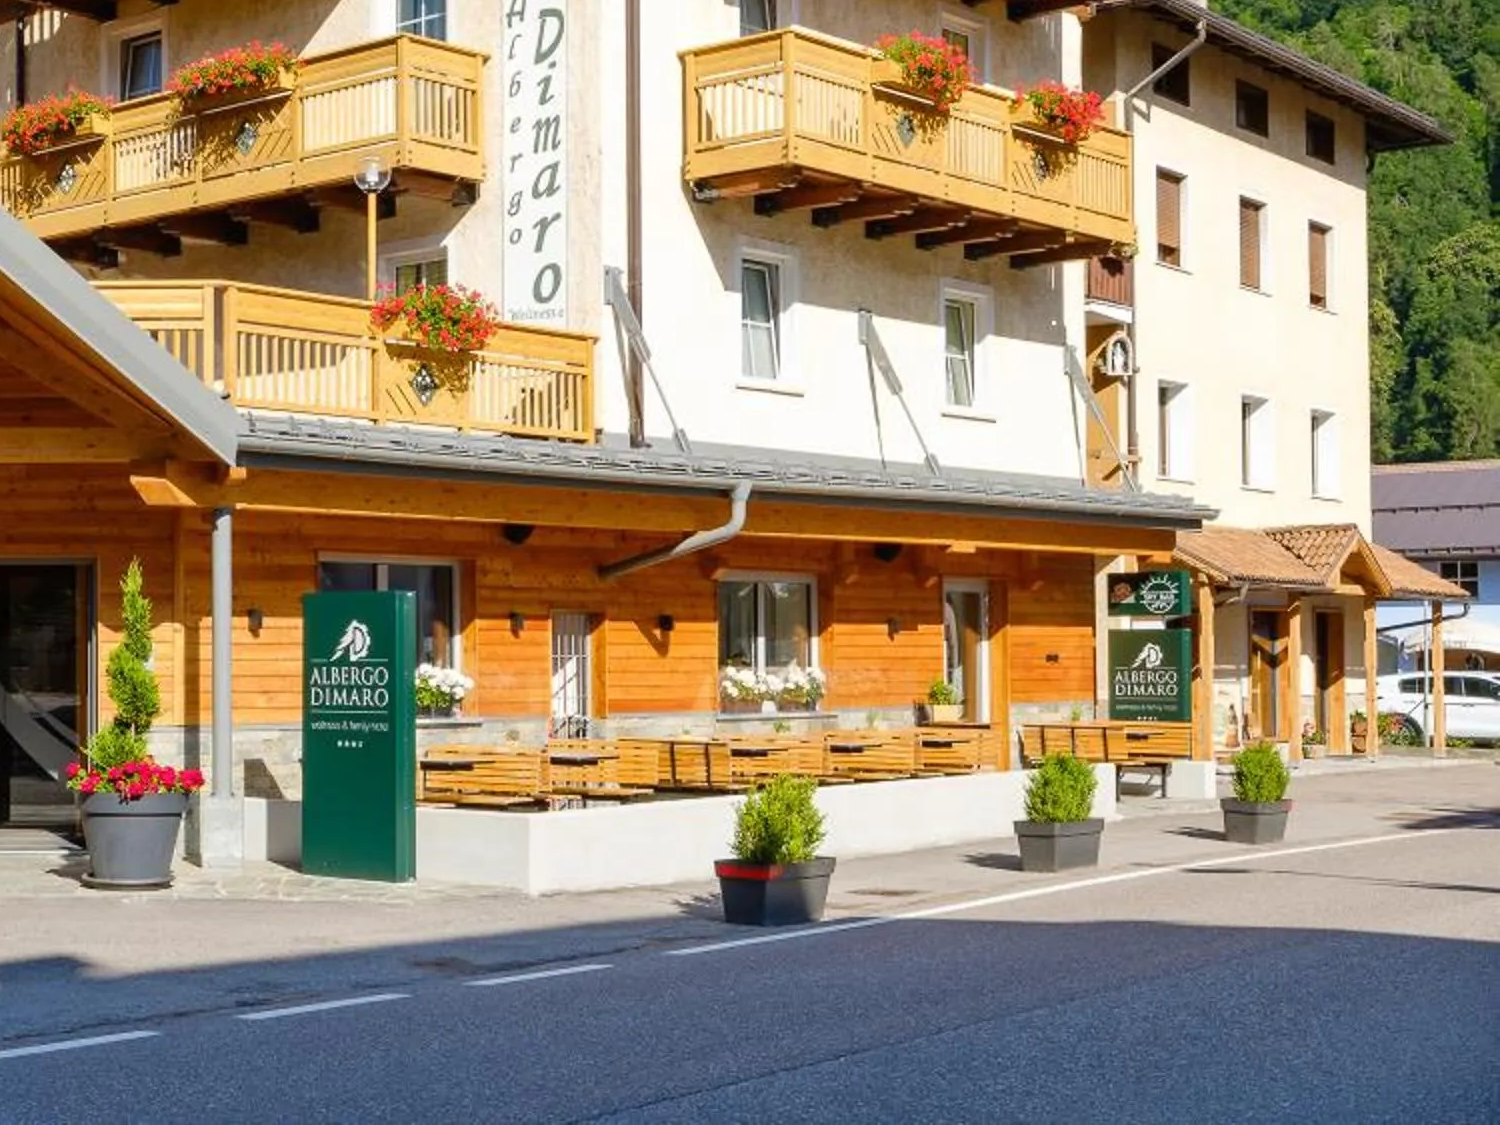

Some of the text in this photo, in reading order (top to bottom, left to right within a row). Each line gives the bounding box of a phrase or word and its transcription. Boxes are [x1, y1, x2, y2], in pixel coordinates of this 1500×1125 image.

[532, 8, 564, 303] Dimaro
[310, 666, 389, 686] ALBERGO
[1115, 670, 1177, 684] ALBERGO
[311, 687, 389, 707] DIMARO
[1115, 684, 1178, 696] DIMARO
